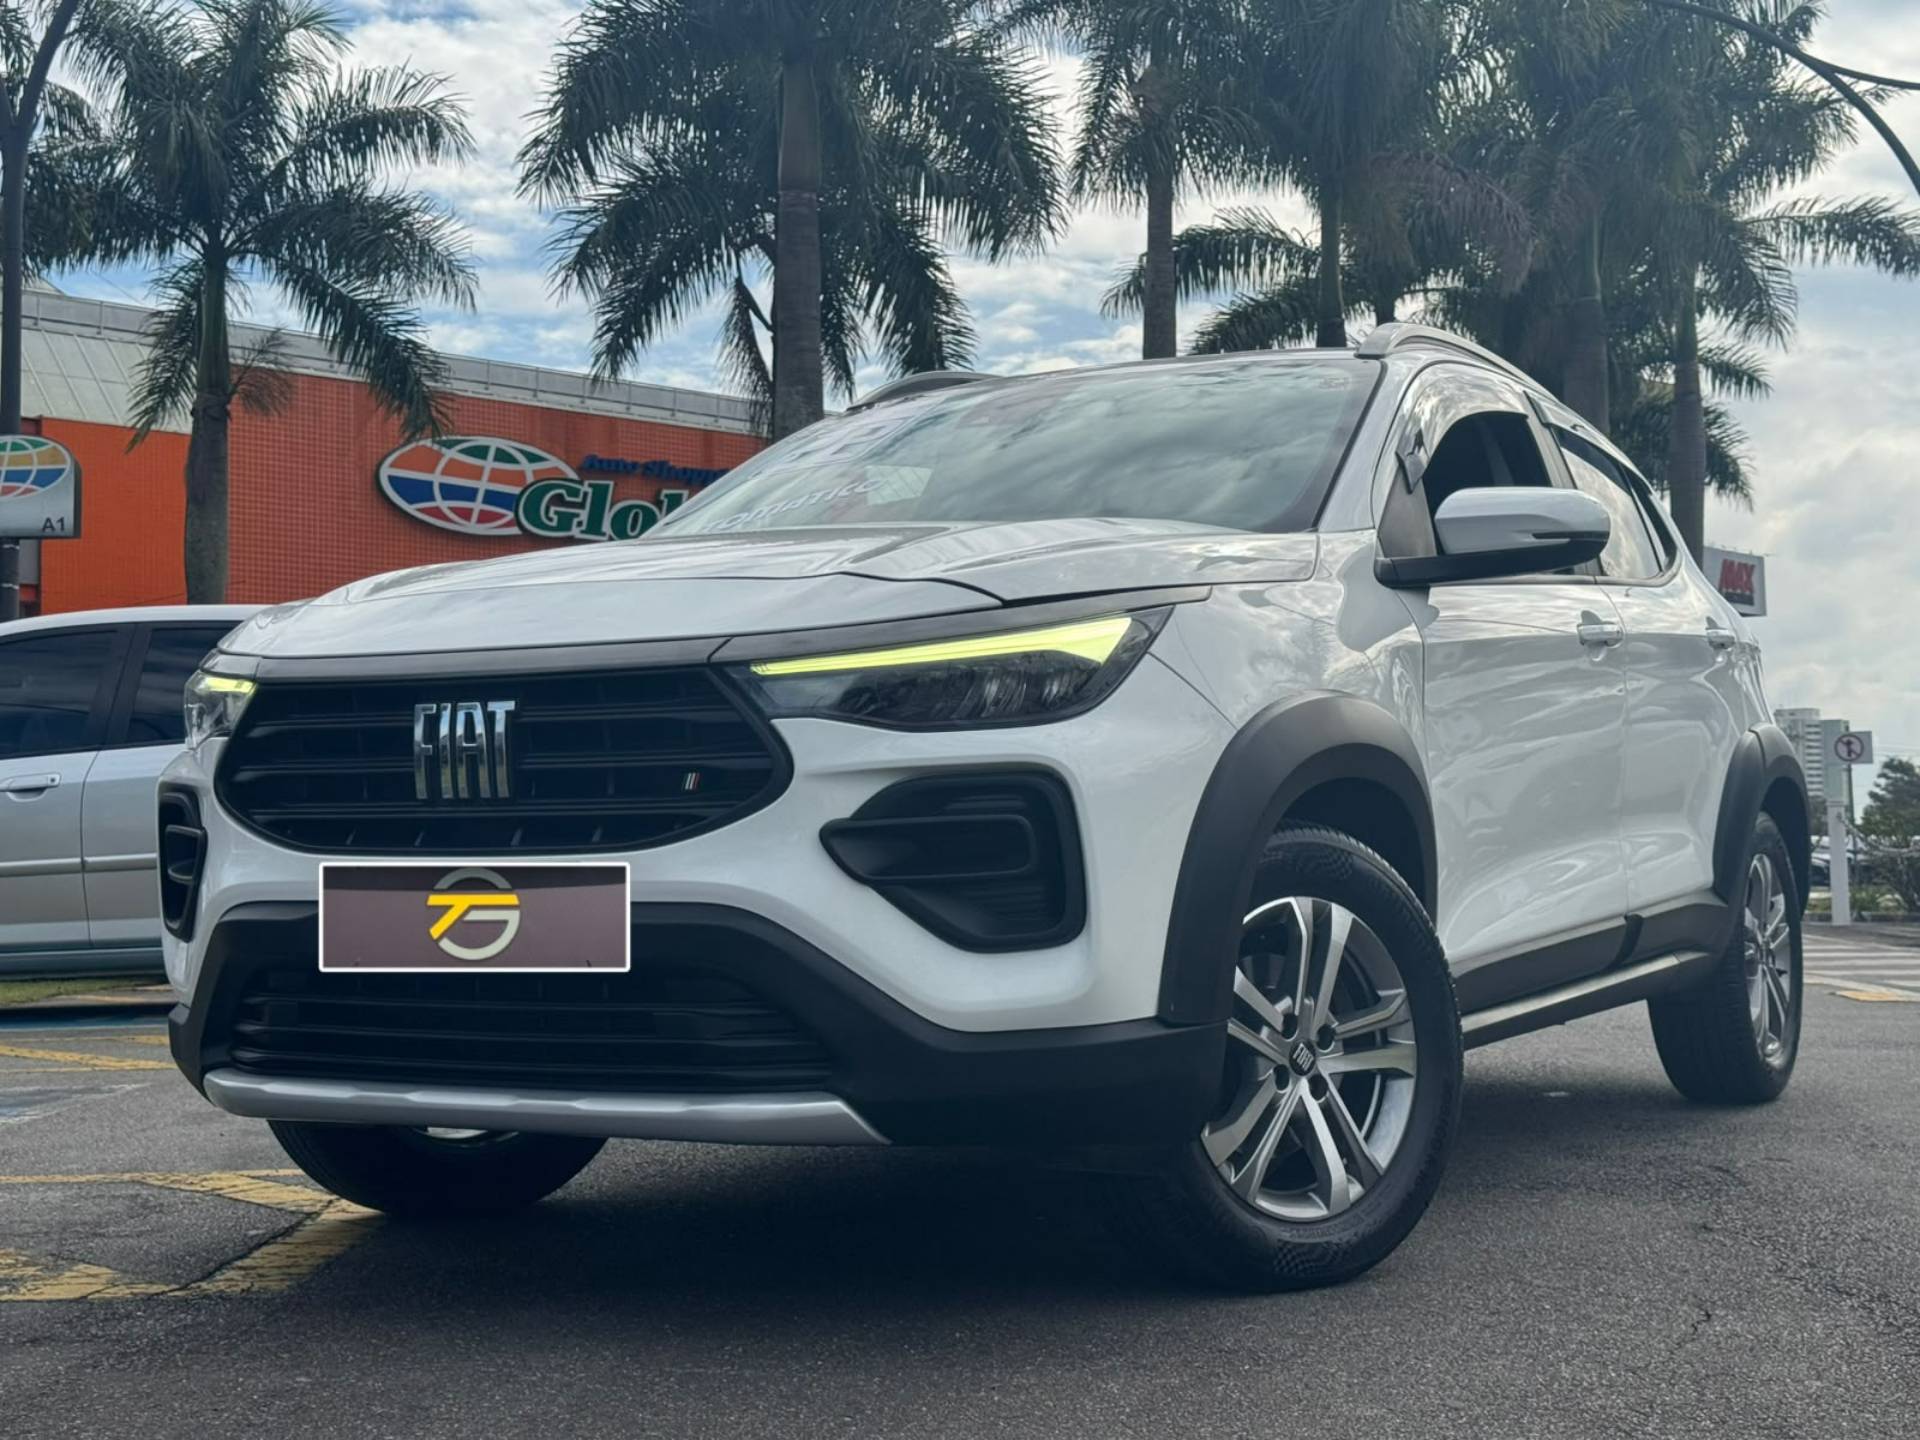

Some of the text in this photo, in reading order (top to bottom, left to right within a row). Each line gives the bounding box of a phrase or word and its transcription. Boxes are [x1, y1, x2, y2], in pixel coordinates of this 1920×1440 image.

[581, 454, 641, 475] Auto
[42, 516, 65, 532] A1
[414, 700, 516, 799] FIAT
